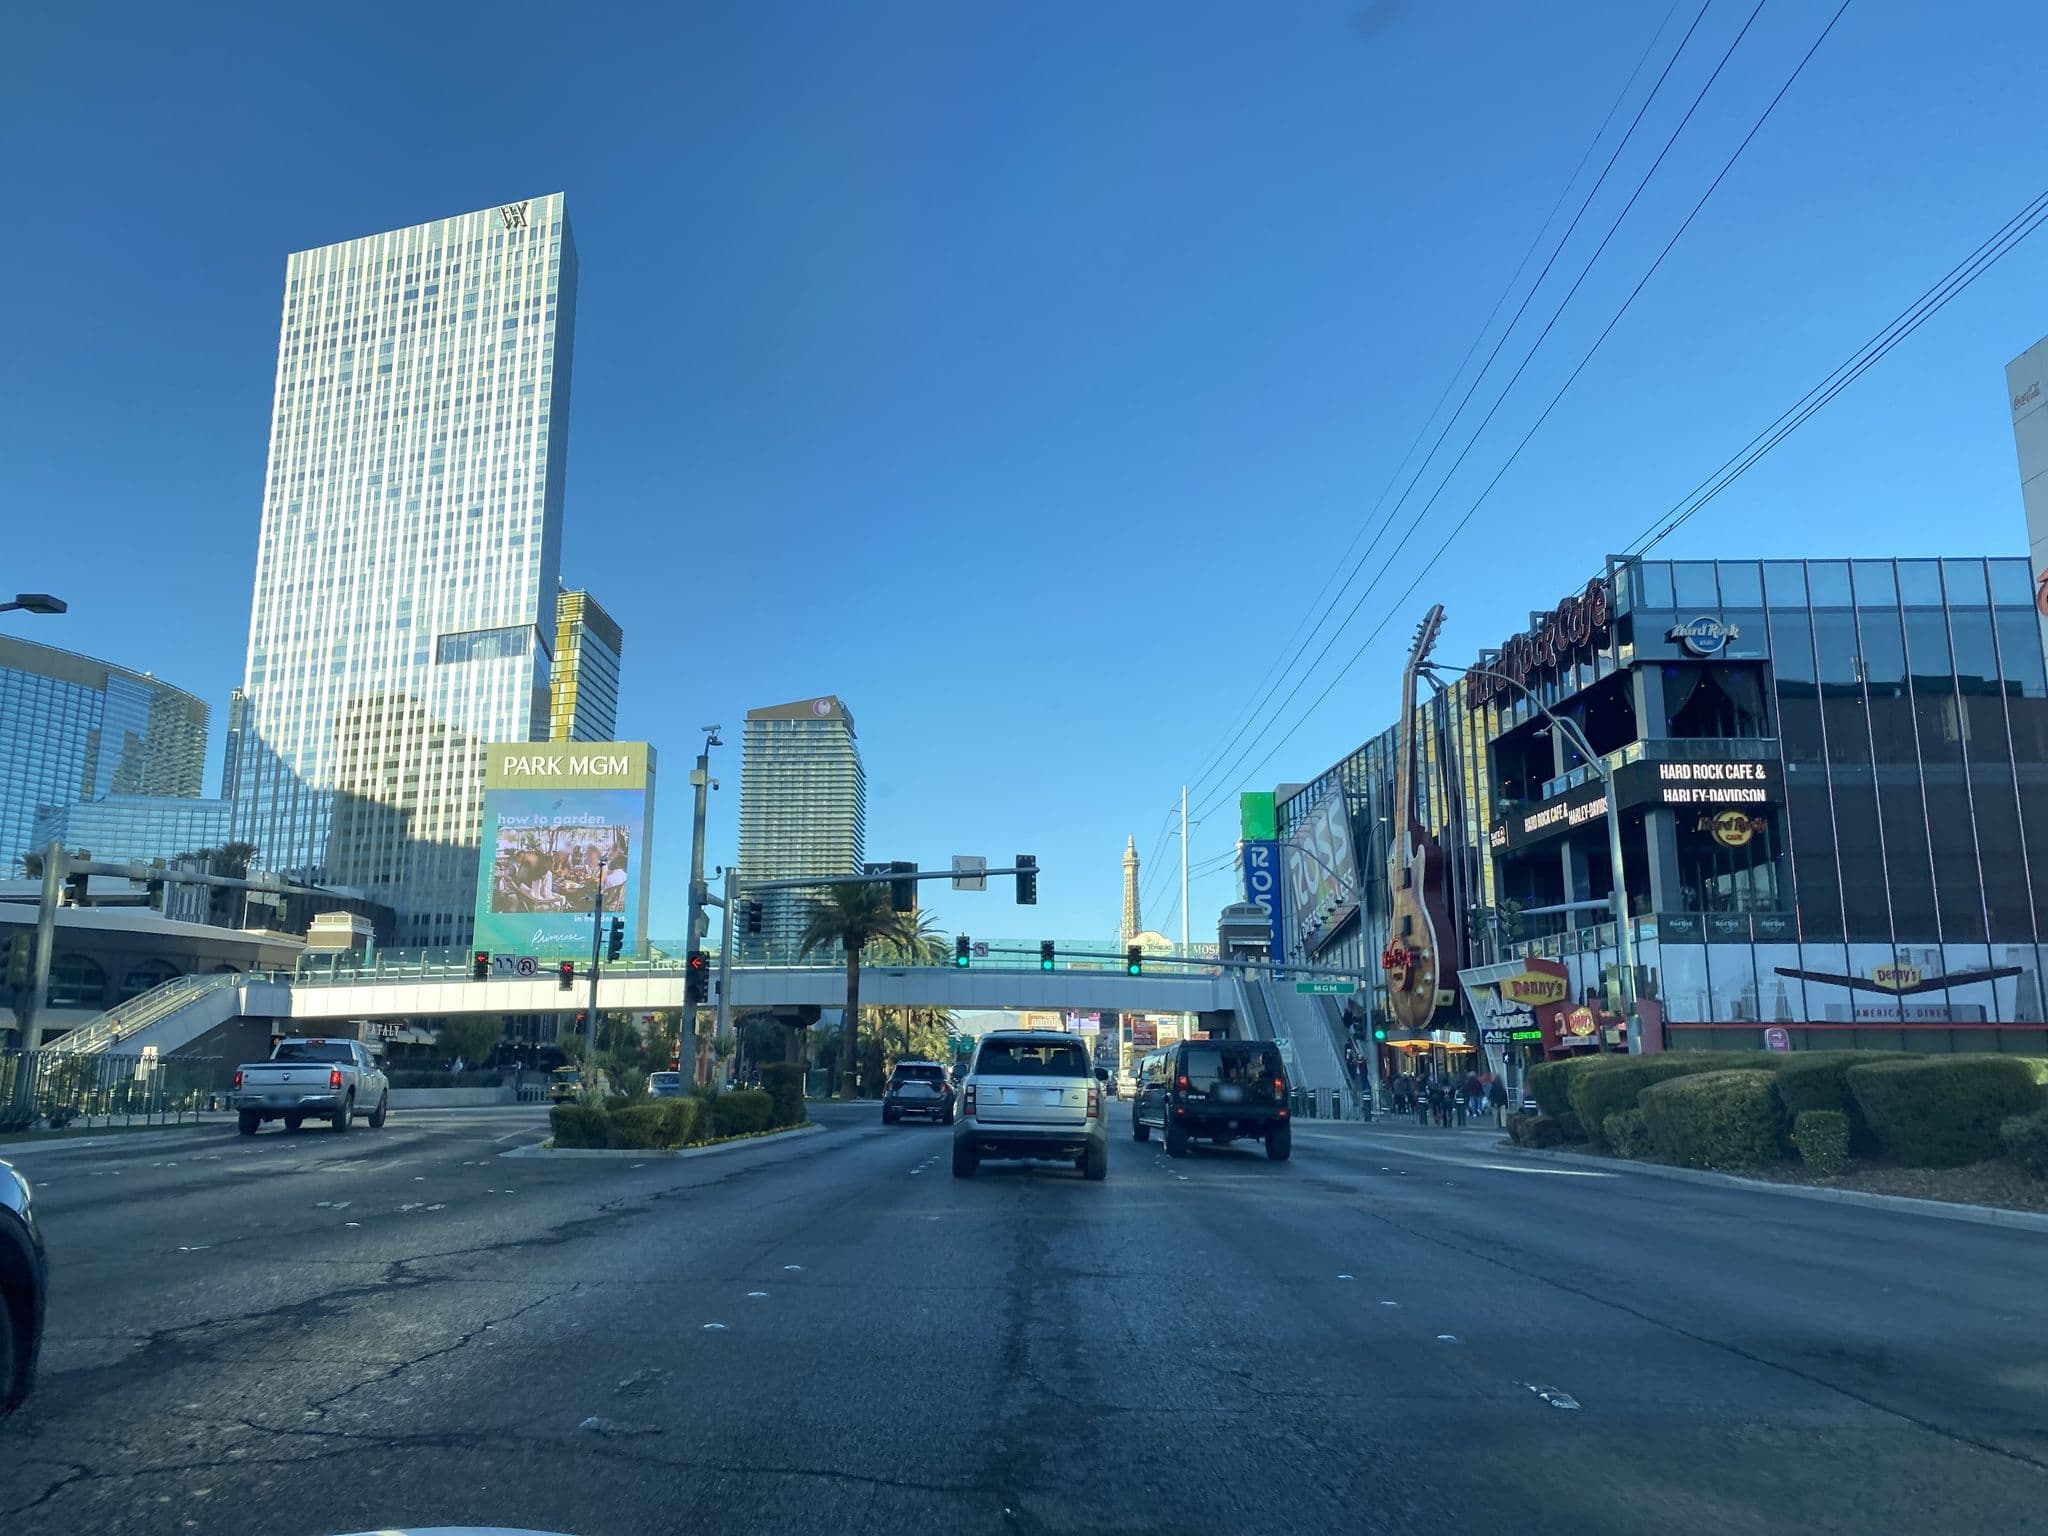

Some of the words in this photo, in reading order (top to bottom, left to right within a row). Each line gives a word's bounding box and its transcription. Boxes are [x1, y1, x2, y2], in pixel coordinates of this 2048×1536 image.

[1671, 623, 1706, 639] Hard
[1708, 623, 1739, 639] Rock
[1466, 641, 1509, 710] Hard
[1510, 611, 1557, 686] Rock
[503, 756, 564, 776] PARK
[569, 755, 630, 776] MGM
[1660, 764, 1691, 779] HARD
[1692, 764, 1724, 780] ROCK
[1725, 764, 1753, 779] CAFE
[1755, 764, 1766, 780] &
[1663, 788, 1766, 801] HARLEY-DAVIDSON
[1524, 814, 1538, 833] HARD
[1537, 809, 1551, 828] ROCK
[1551, 803, 1564, 823] CAFE
[1568, 796, 1609, 826] HARLEY-DAVIDS
[497, 812, 529, 825] how
[534, 813, 547, 825] to
[552, 812, 605, 827] garden
[1289, 797, 1348, 911] ROSS
[1251, 847, 1273, 939] ROS
[574, 915, 582, 923] in
[1193, 944, 1220, 954] MOS
[1877, 968, 1917, 983] Denny's
[1511, 978, 1563, 998] Denny's
[1492, 1013, 1534, 1029] STORES
[1485, 1030, 1511, 1039] ABC
